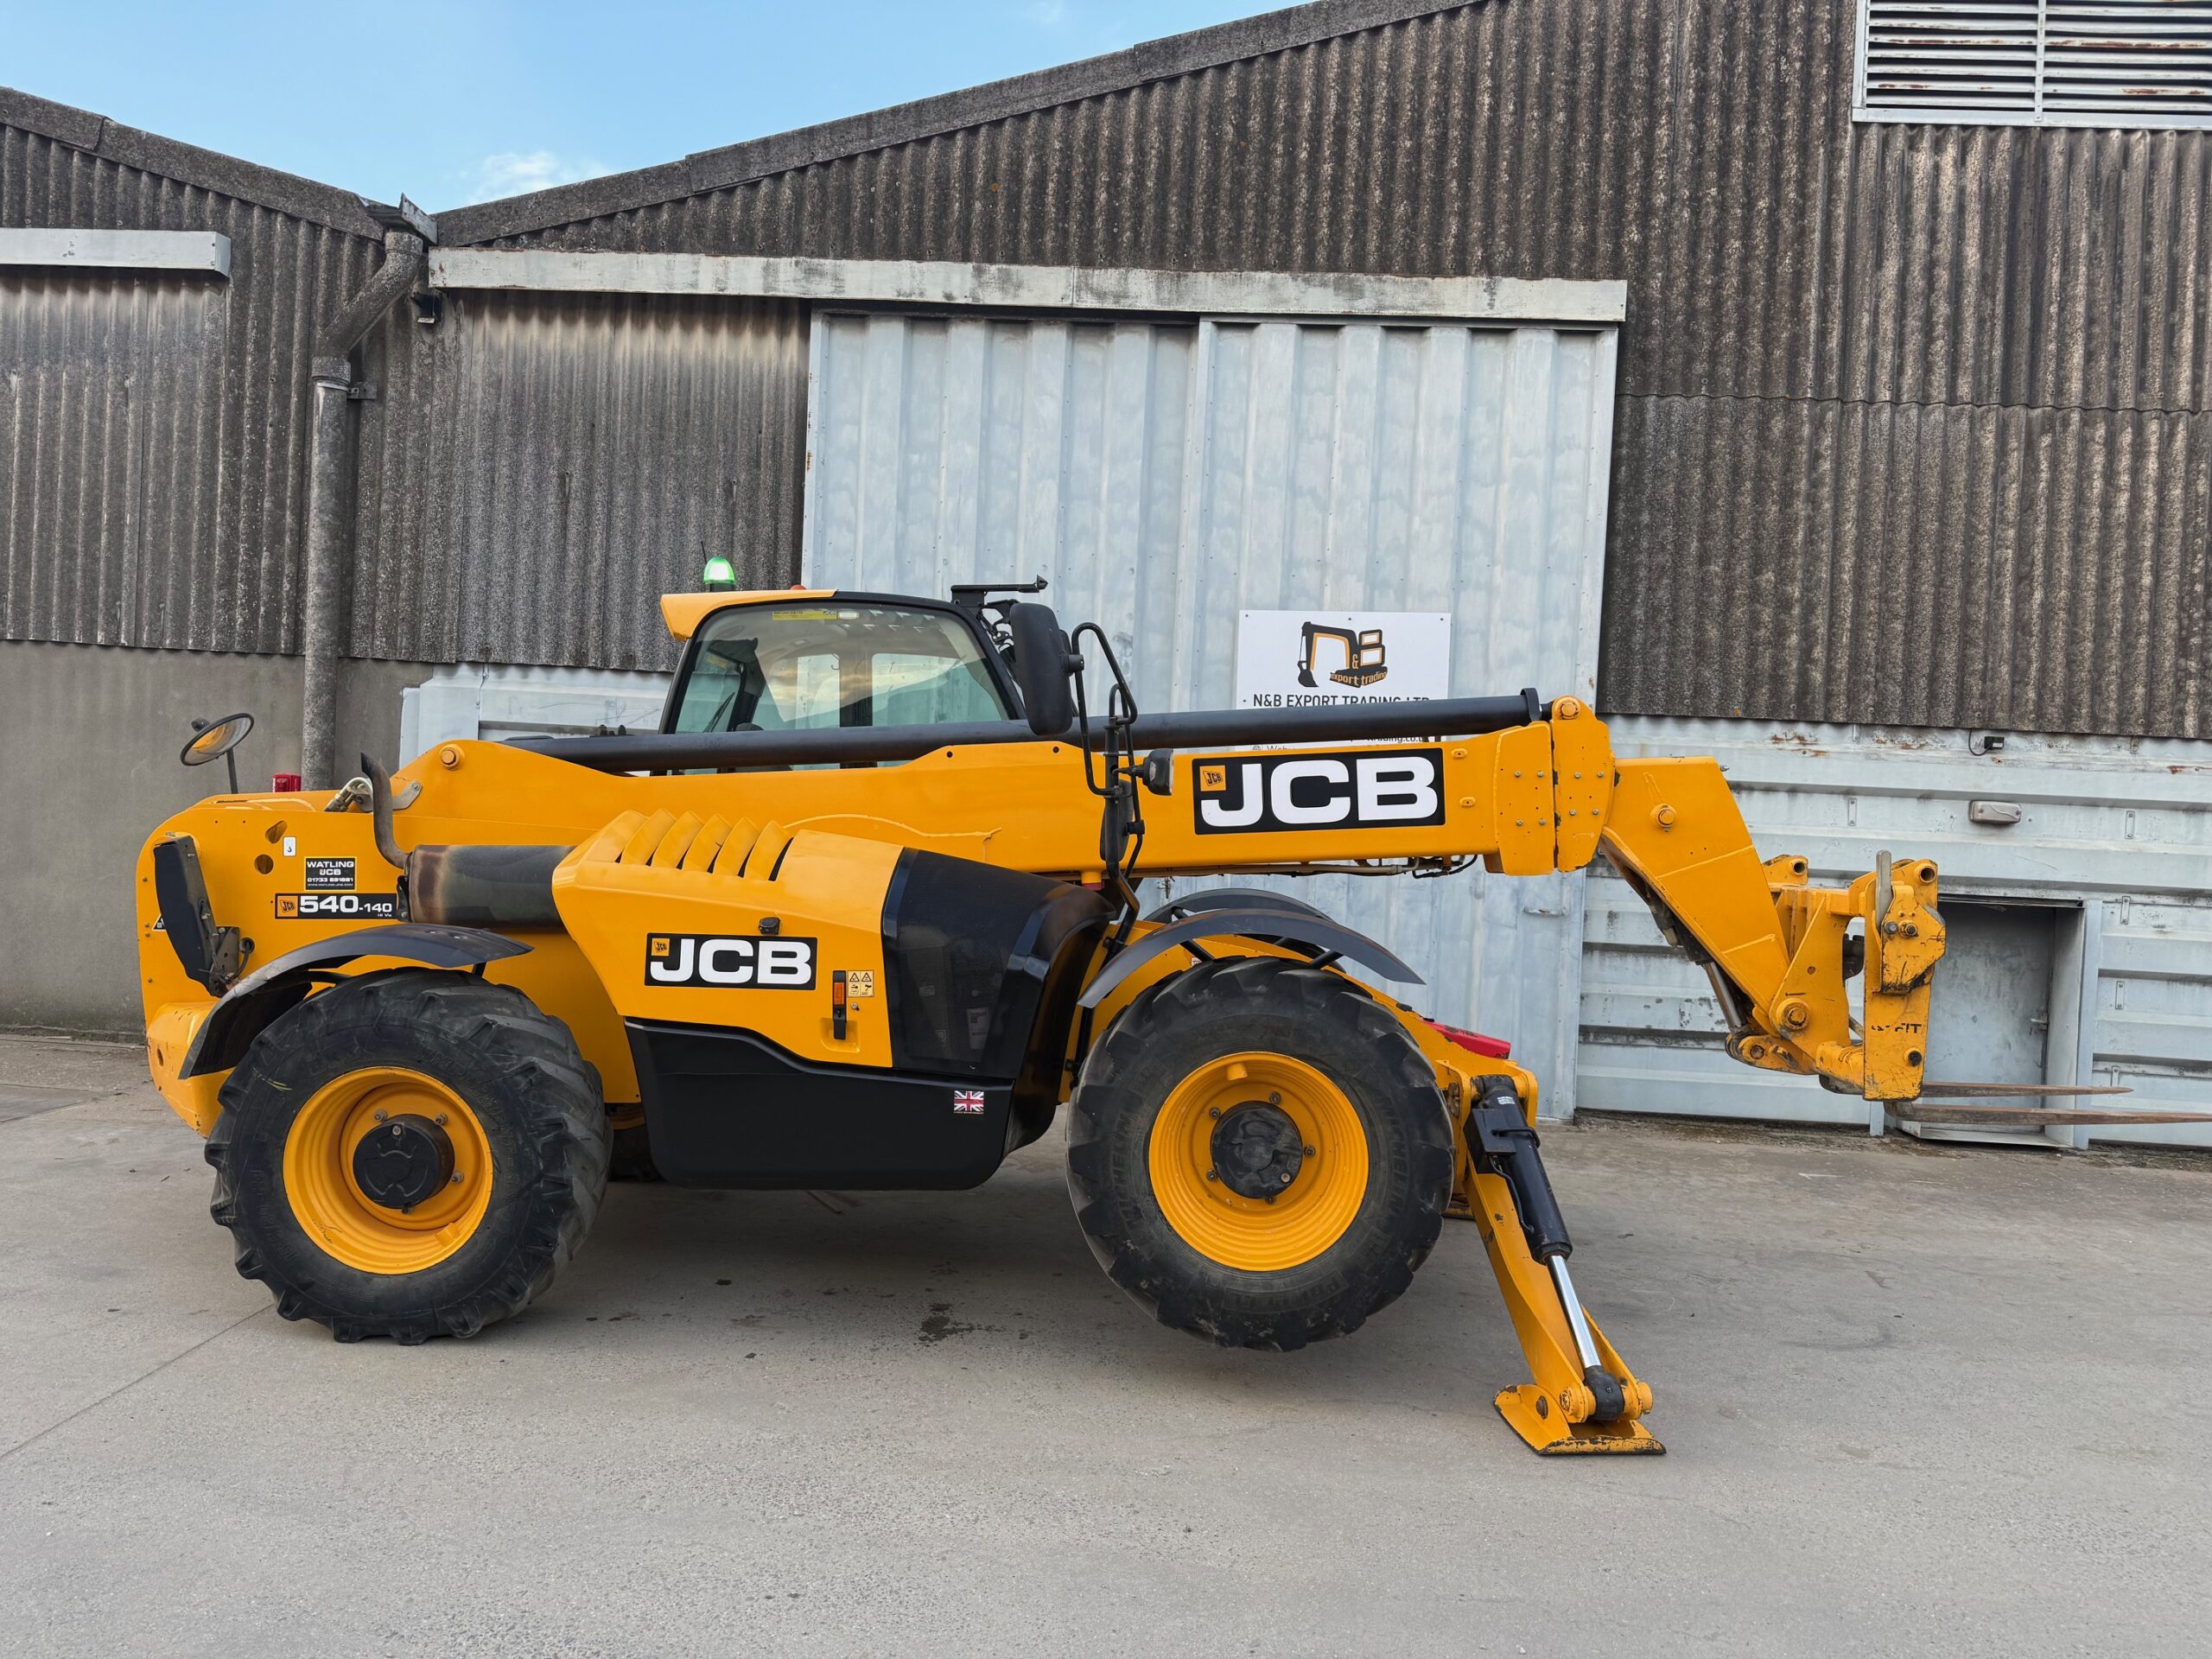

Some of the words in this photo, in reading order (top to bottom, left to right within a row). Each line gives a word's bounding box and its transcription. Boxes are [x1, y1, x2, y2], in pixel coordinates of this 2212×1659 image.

[1331, 673, 1360, 686] export
[1253, 694, 1281, 707] N&B
[1287, 695, 1338, 707] EXPORT
[1205, 771, 1223, 785] JCB
[1200, 756, 1438, 827] JCB
[281, 899, 296, 912] JCB
[300, 895, 392, 913] 540-140
[655, 942, 666, 952] JCB
[650, 938, 811, 985] JCB
